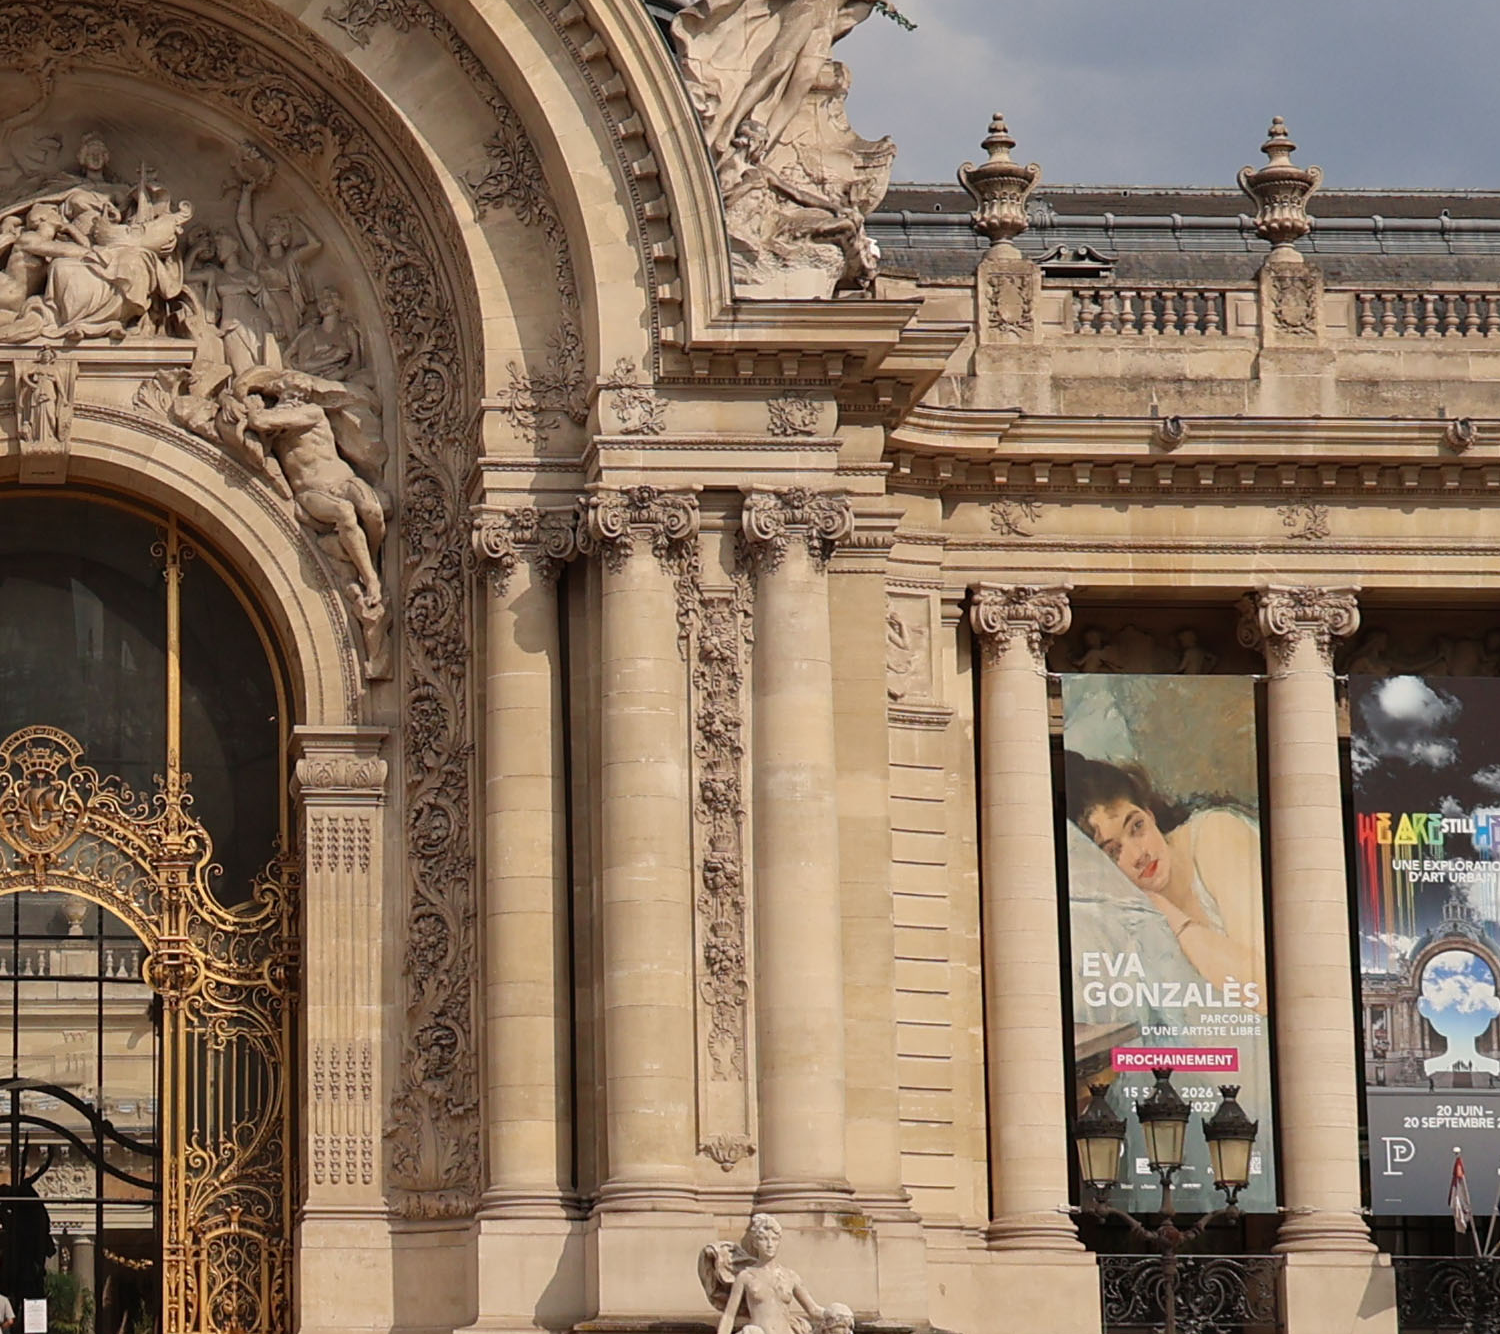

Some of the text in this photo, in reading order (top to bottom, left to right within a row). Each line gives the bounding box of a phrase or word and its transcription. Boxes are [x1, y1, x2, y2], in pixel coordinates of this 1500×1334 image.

[1358, 812, 1393, 845] WE
[1394, 812, 1445, 845] ARE
[1440, 818, 1477, 834] STILL
[1392, 859, 1420, 871] UNE
[1408, 872, 1497, 884] D'ART URBAIN
[1082, 952, 1146, 978] EVA
[1083, 976, 1261, 1008] GONZALÈS
[1200, 1013, 1262, 1025] PARCOURS
[1181, 1025, 1226, 1037] ARTISTE
[1230, 1026, 1262, 1037] LIBRE
[1117, 1053, 1233, 1066] PROCHAINEMENT
[1123, 1087, 1139, 1098] 15
[1181, 1087, 1214, 1098] 2026
[1436, 1105, 1453, 1117] 20
[1454, 1105, 1484, 1117] JUIN
[1404, 1117, 1420, 1129] 20
[1421, 1117, 1496, 1129] SEPTEMBRE
